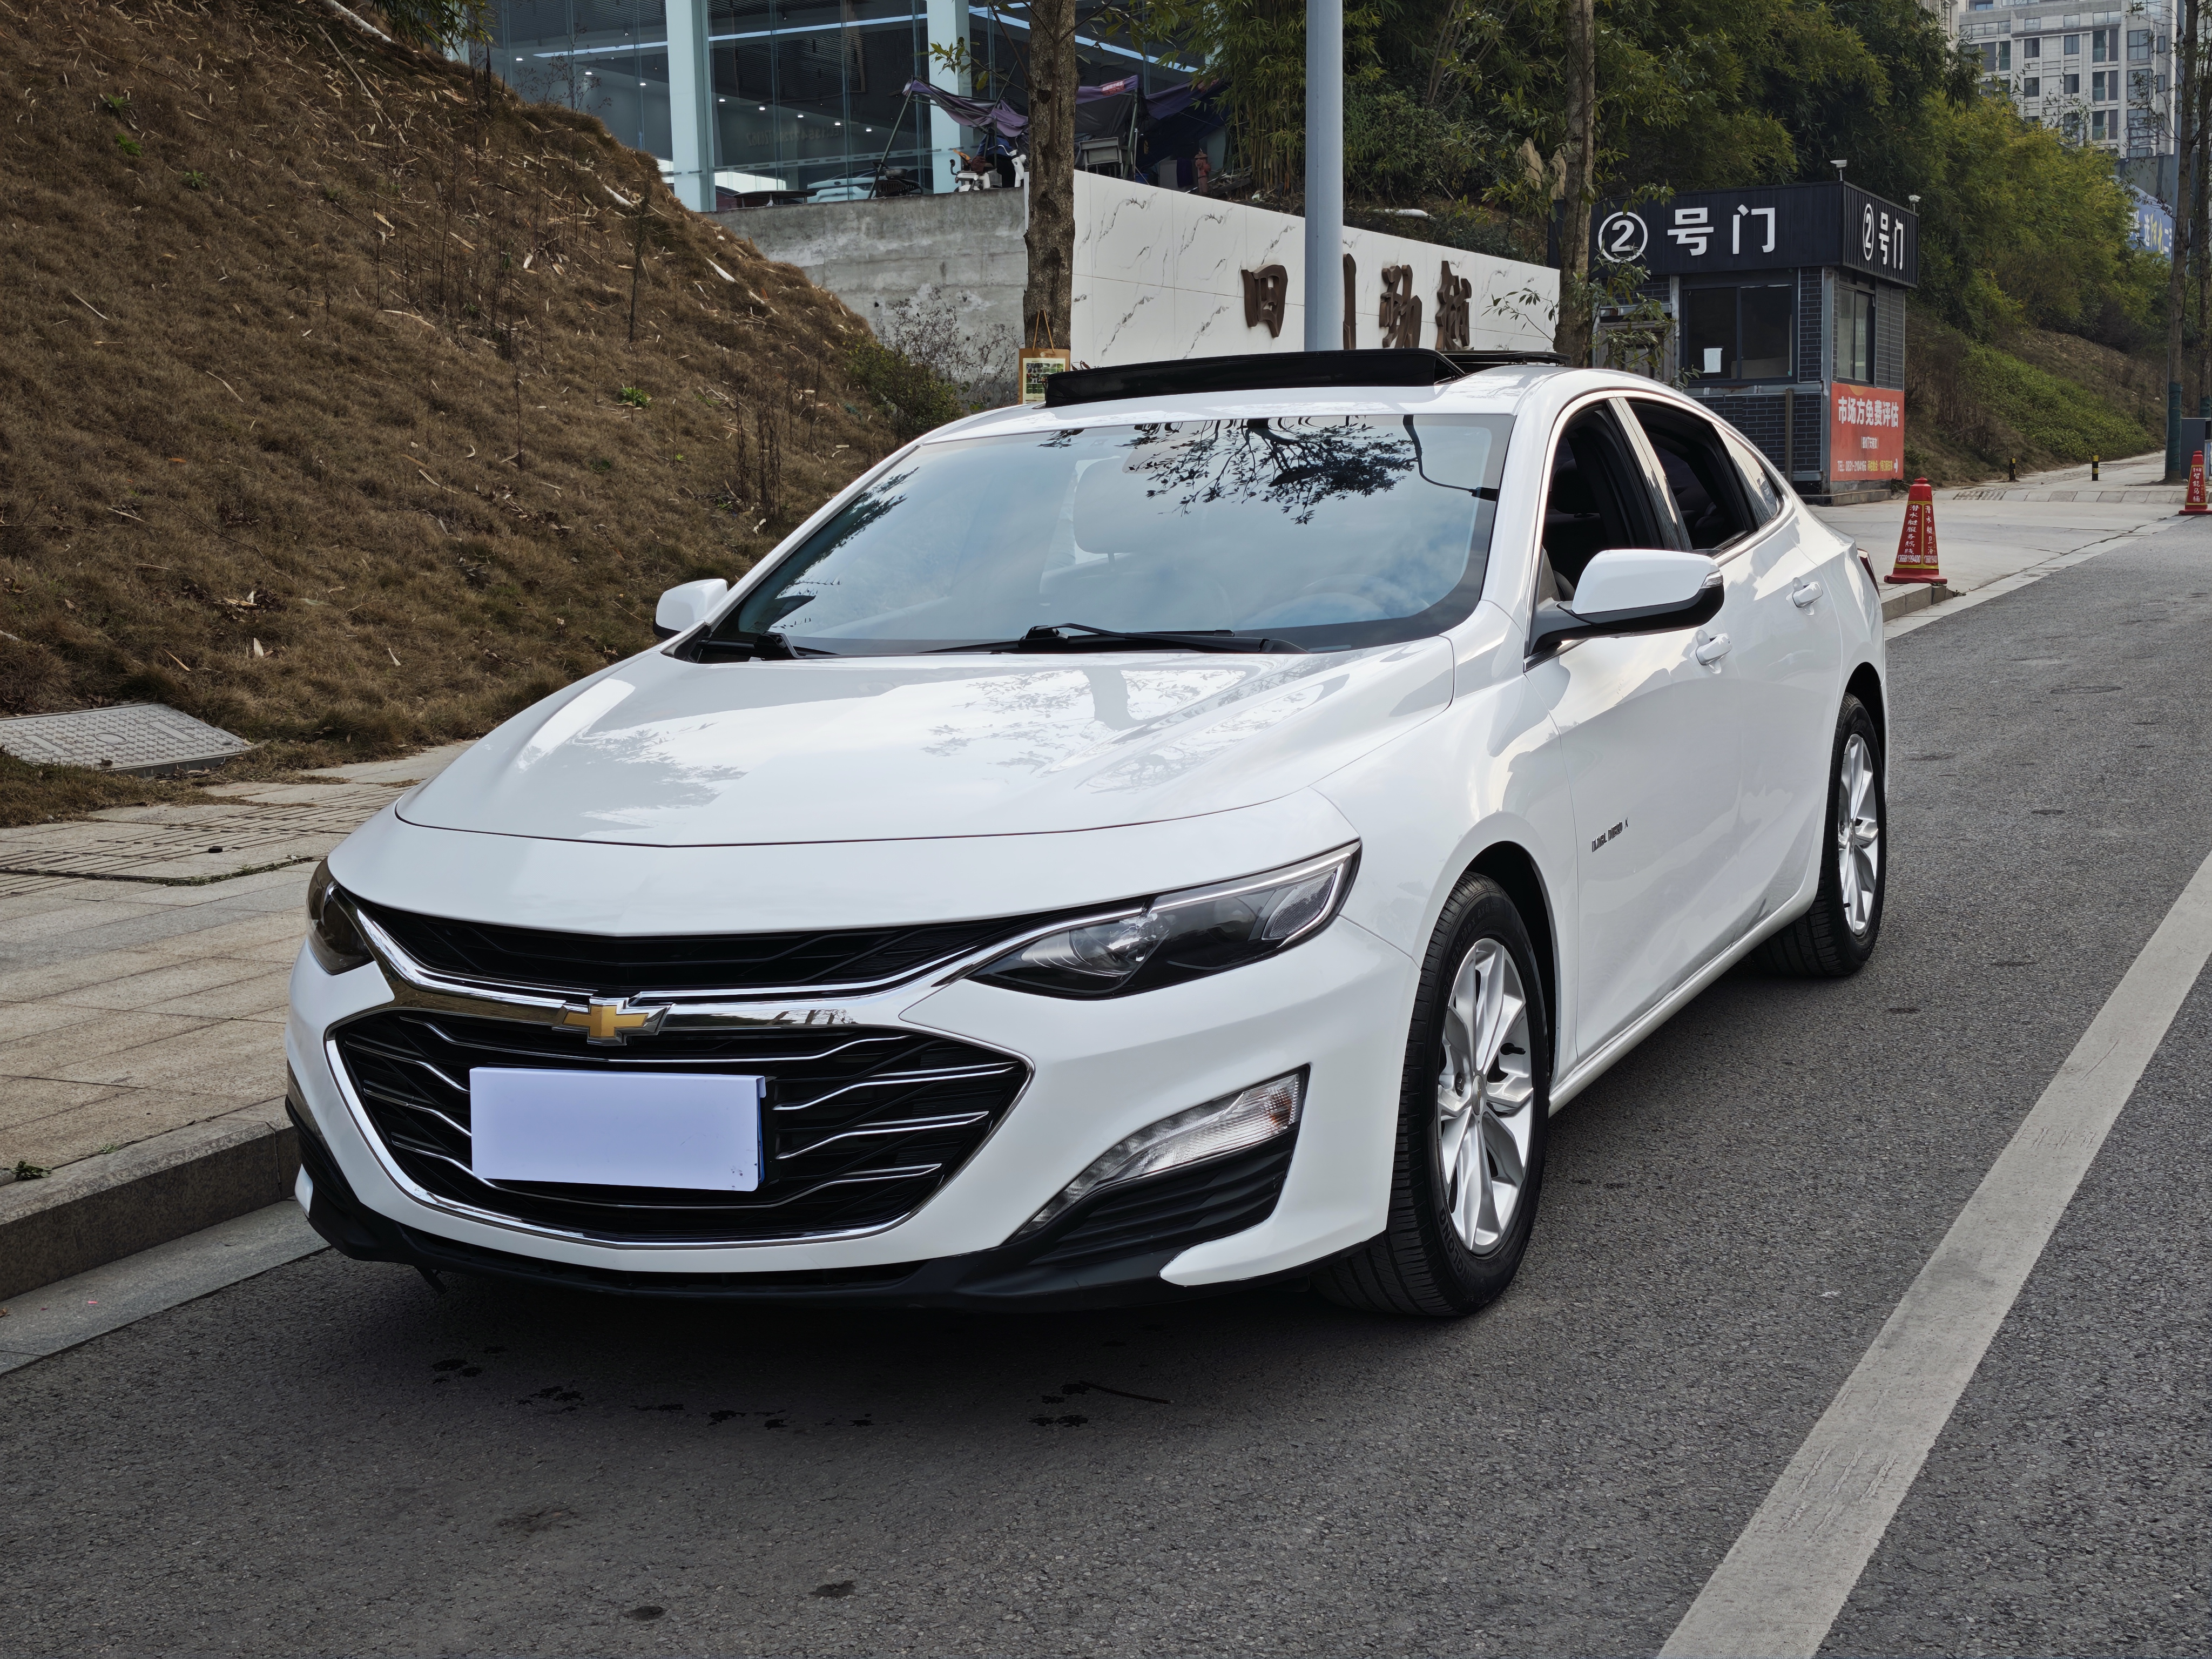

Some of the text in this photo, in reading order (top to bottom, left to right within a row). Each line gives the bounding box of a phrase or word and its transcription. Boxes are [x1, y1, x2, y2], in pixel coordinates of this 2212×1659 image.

[1838, 396, 1899, 428] 市场方免费评估
